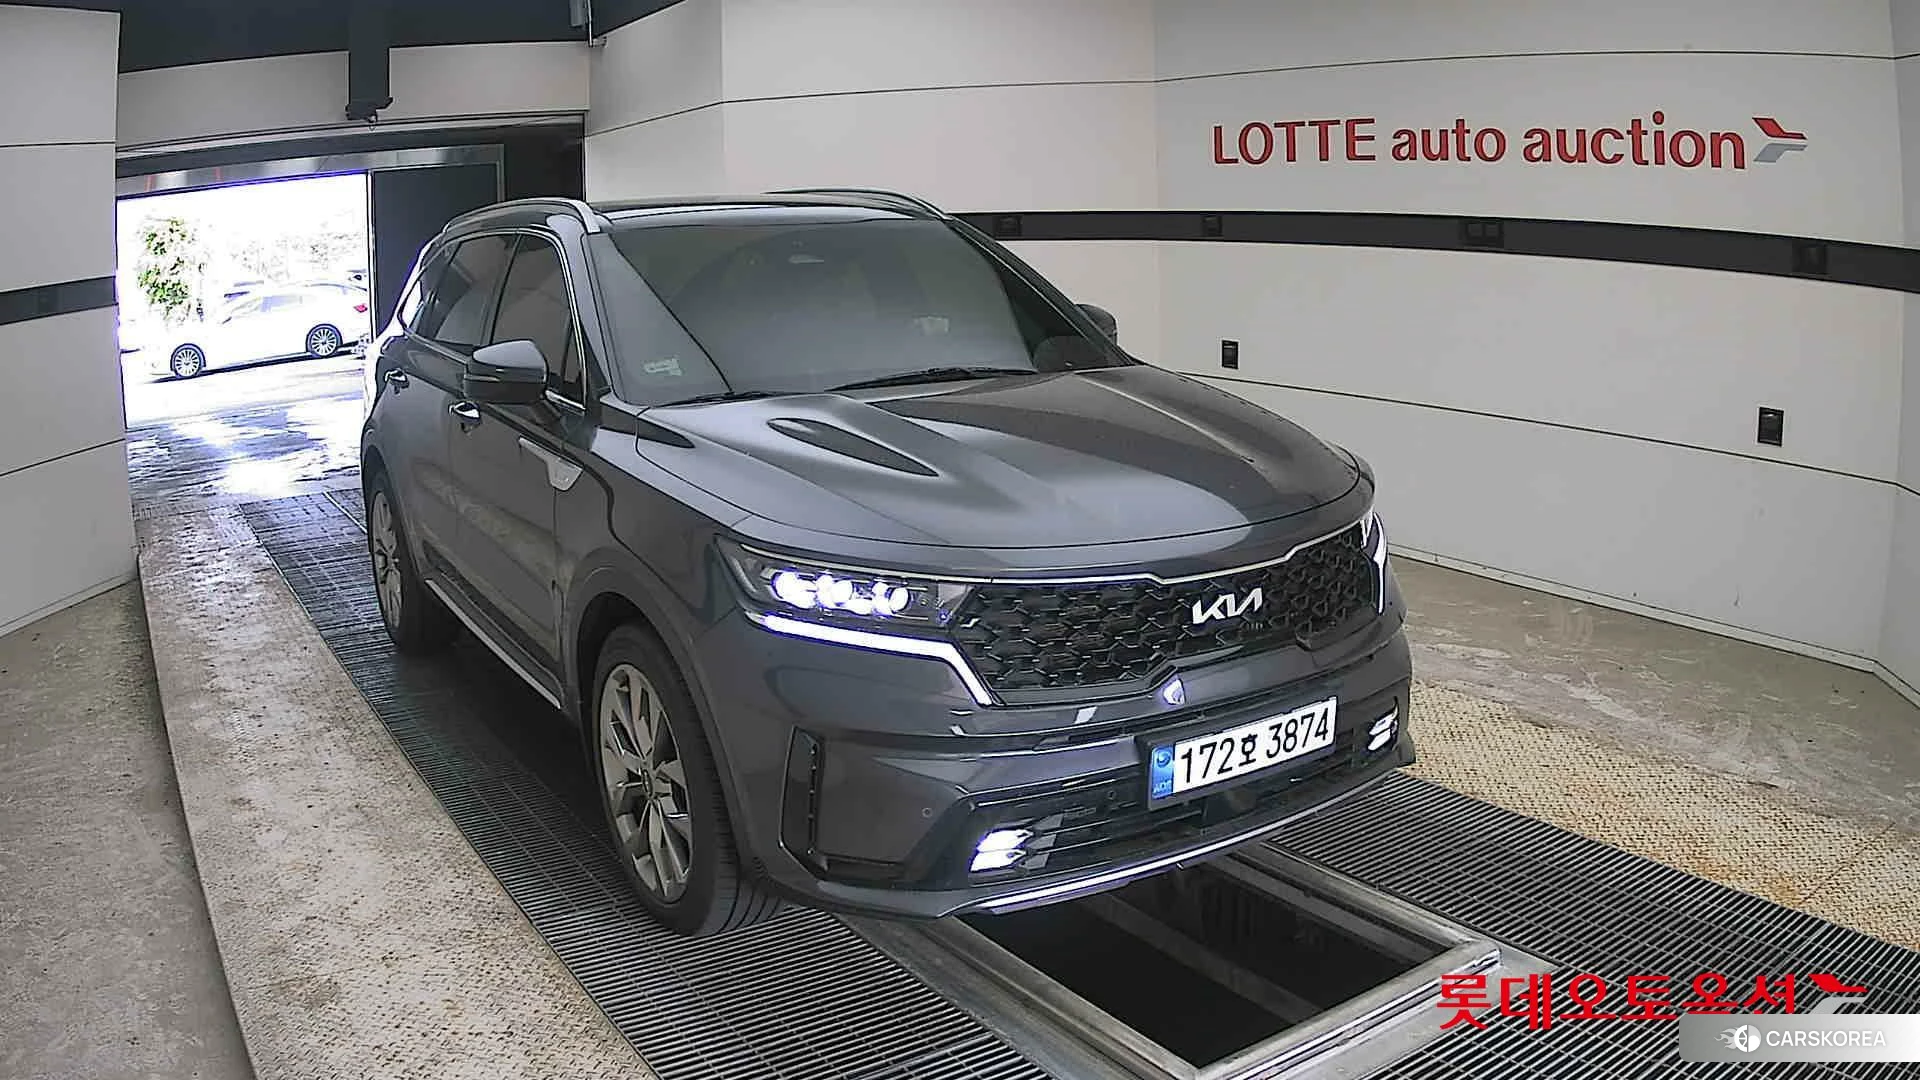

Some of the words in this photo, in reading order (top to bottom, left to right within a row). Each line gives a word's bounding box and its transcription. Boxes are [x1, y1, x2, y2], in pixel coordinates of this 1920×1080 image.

[1214, 118, 1376, 164] LOTTE
[1392, 119, 1507, 162] auto
[1523, 111, 1746, 169] auction
[1191, 587, 1263, 625] KIA
[1180, 734, 1258, 784] 172호
[1266, 707, 1329, 759] 3874
